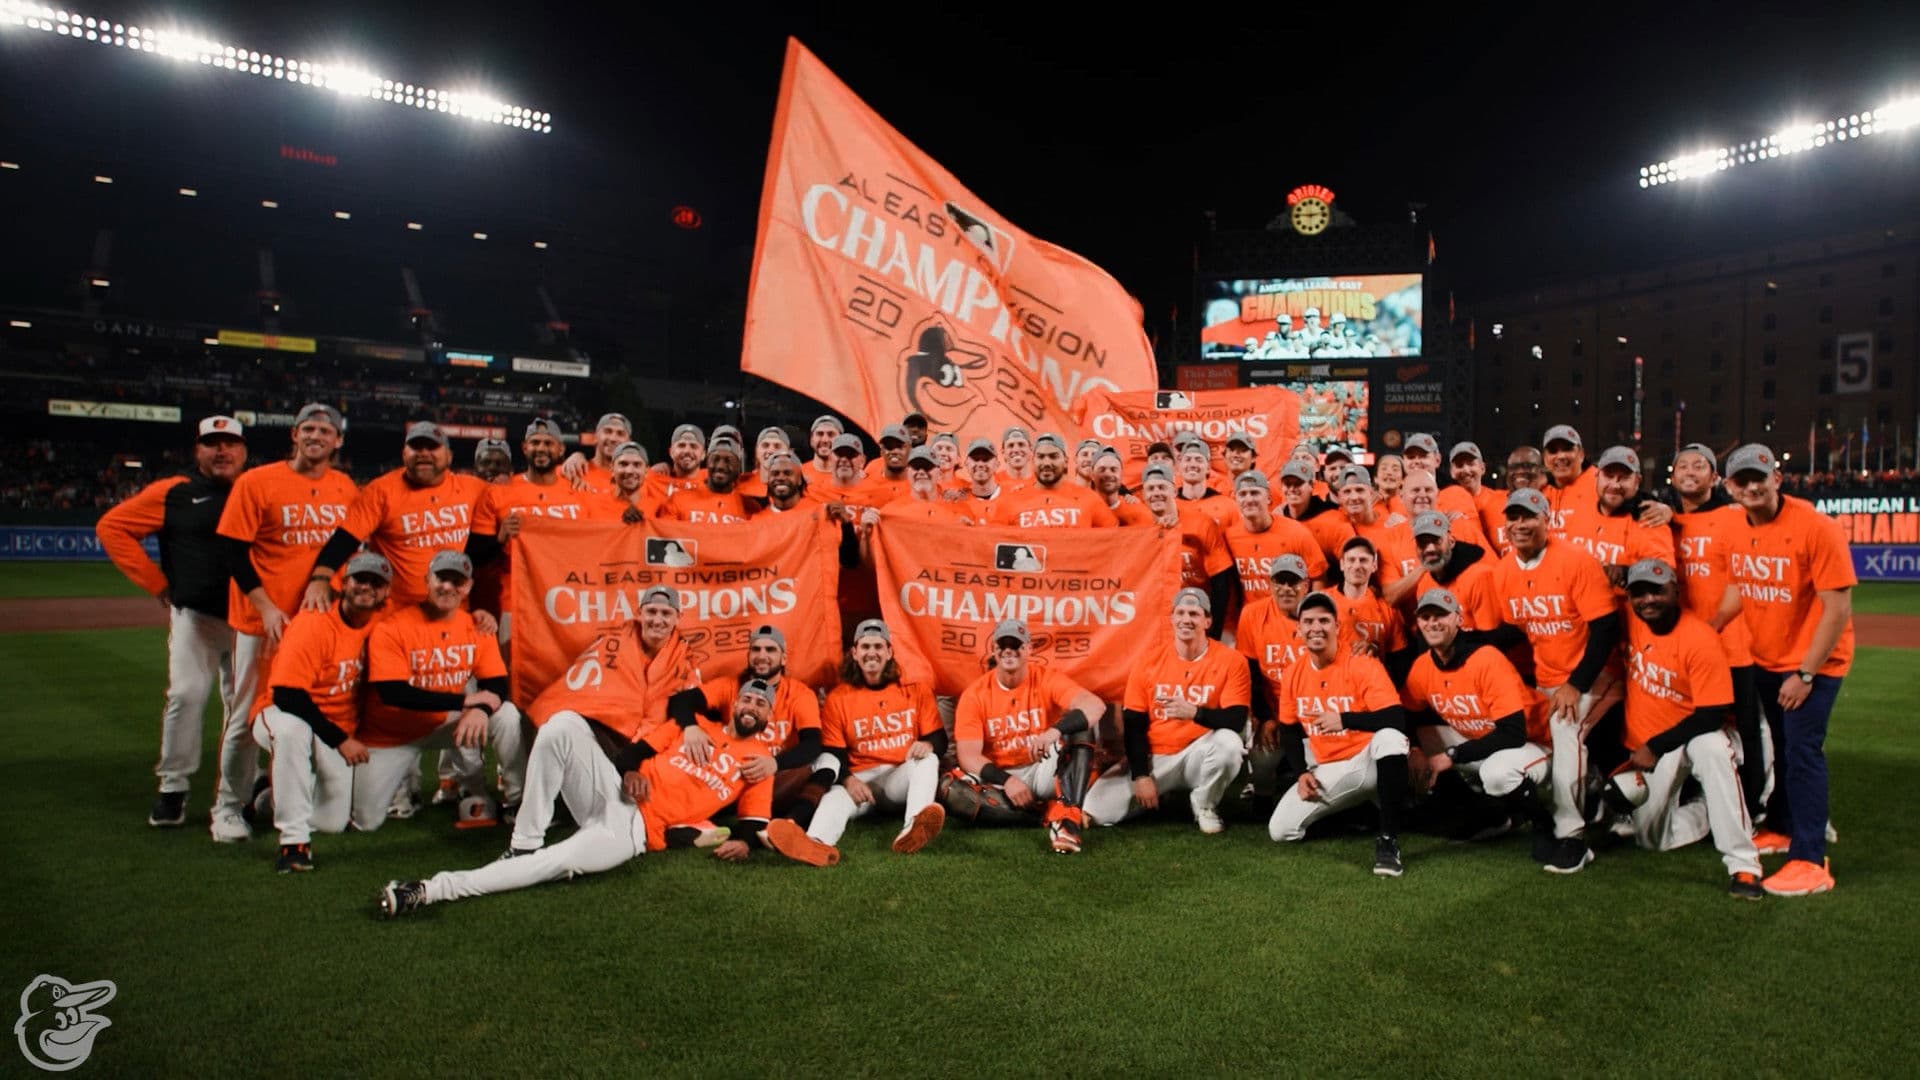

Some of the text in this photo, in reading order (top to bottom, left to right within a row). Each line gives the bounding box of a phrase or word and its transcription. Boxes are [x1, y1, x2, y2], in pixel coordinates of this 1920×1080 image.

[838, 172, 876, 204] AL
[1287, 185, 1335, 204] ORIOLES
[1241, 290, 1376, 323] CHAMPIONS
[849, 286, 1045, 423] 20 23
[1840, 341, 1868, 384] 5
[1815, 497, 1920, 513] AMERICAN L
[402, 503, 470, 535] EAST
[1019, 508, 1081, 529] EAST
[1840, 513, 1920, 543] CHAM
[282, 529, 337, 545] CHAM
[405, 529, 471, 548] HAMP
[1680, 536, 1712, 558] ST
[565, 565, 779, 586] AL EAST DIVISION
[1236, 556, 1274, 577] EAS
[1731, 553, 1791, 581] EAST
[917, 568, 1122, 592] AL EAST DIVISION
[544, 577, 799, 625] CHAPIONS
[900, 581, 1136, 627] CHAMPIONS
[1738, 582, 1793, 603] AMPS
[1509, 595, 1565, 619] EAST
[942, 630, 1091, 654] 20 23
[1354, 622, 1386, 640] ST
[410, 644, 477, 672] EAST
[1266, 644, 1308, 665] EA
[1628, 645, 1678, 688] AST
[1154, 683, 1216, 706] EAST
[1431, 693, 1481, 716] EAST
[1296, 696, 1354, 718] EAST
[853, 708, 917, 740] EAST
[987, 707, 1044, 738] EAST
[857, 731, 914, 753] CHAMP
[669, 755, 732, 801] CHAMPS
